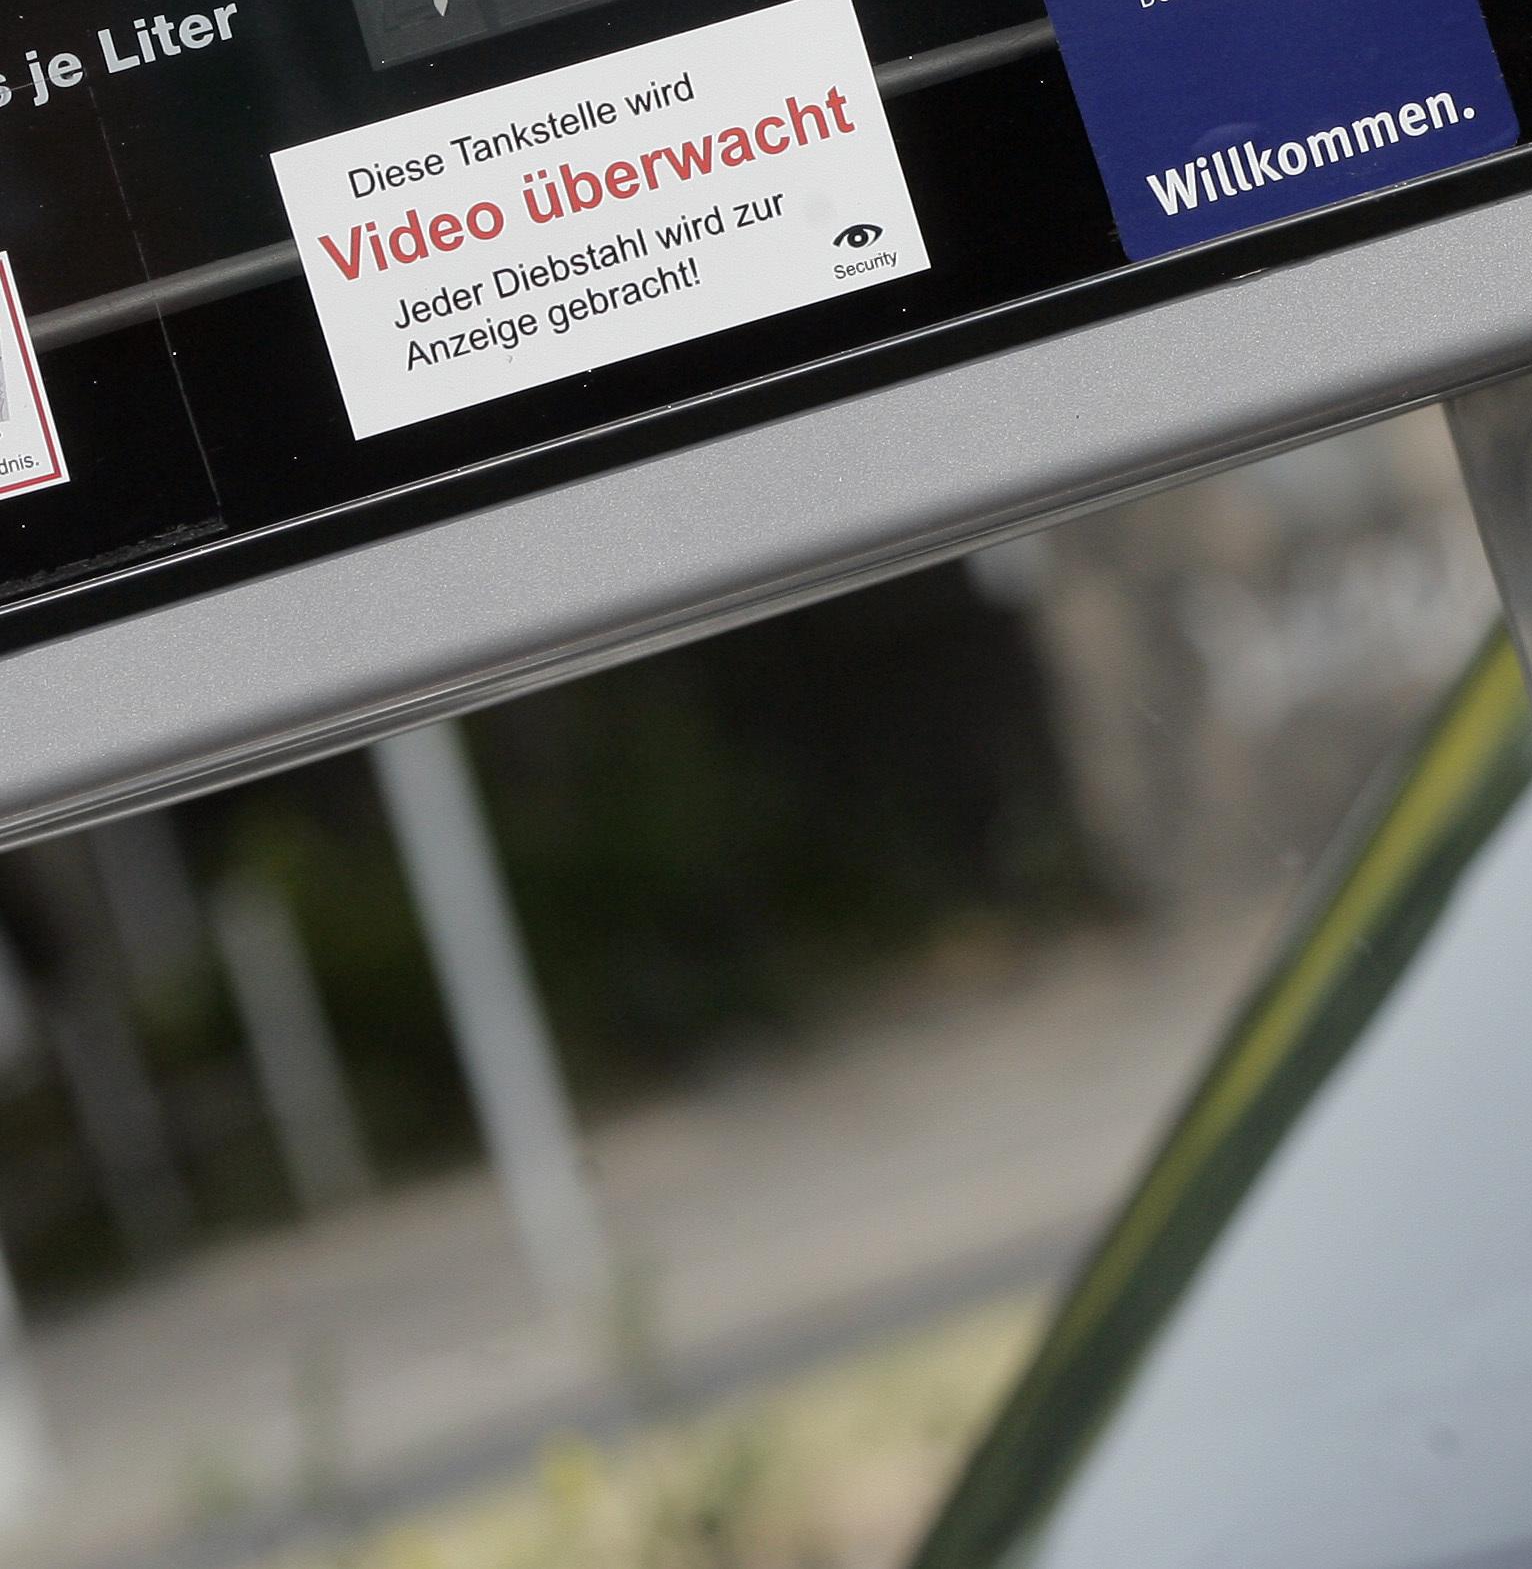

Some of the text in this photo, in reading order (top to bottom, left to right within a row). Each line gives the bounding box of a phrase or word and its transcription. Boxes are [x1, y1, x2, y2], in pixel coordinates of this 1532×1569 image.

[25, 49, 84, 107] je
[97, 2, 238, 74] Liter
[318, 85, 857, 283] Video überwacht
[348, 72, 696, 199] Diese Tankstelle wird
[1146, 89, 1477, 216] Willkommen.
[391, 189, 786, 333] Jeder Diebstahl wird zur
[405, 255, 703, 372] Anzeige gebracht!
[832, 247, 899, 281] Security
